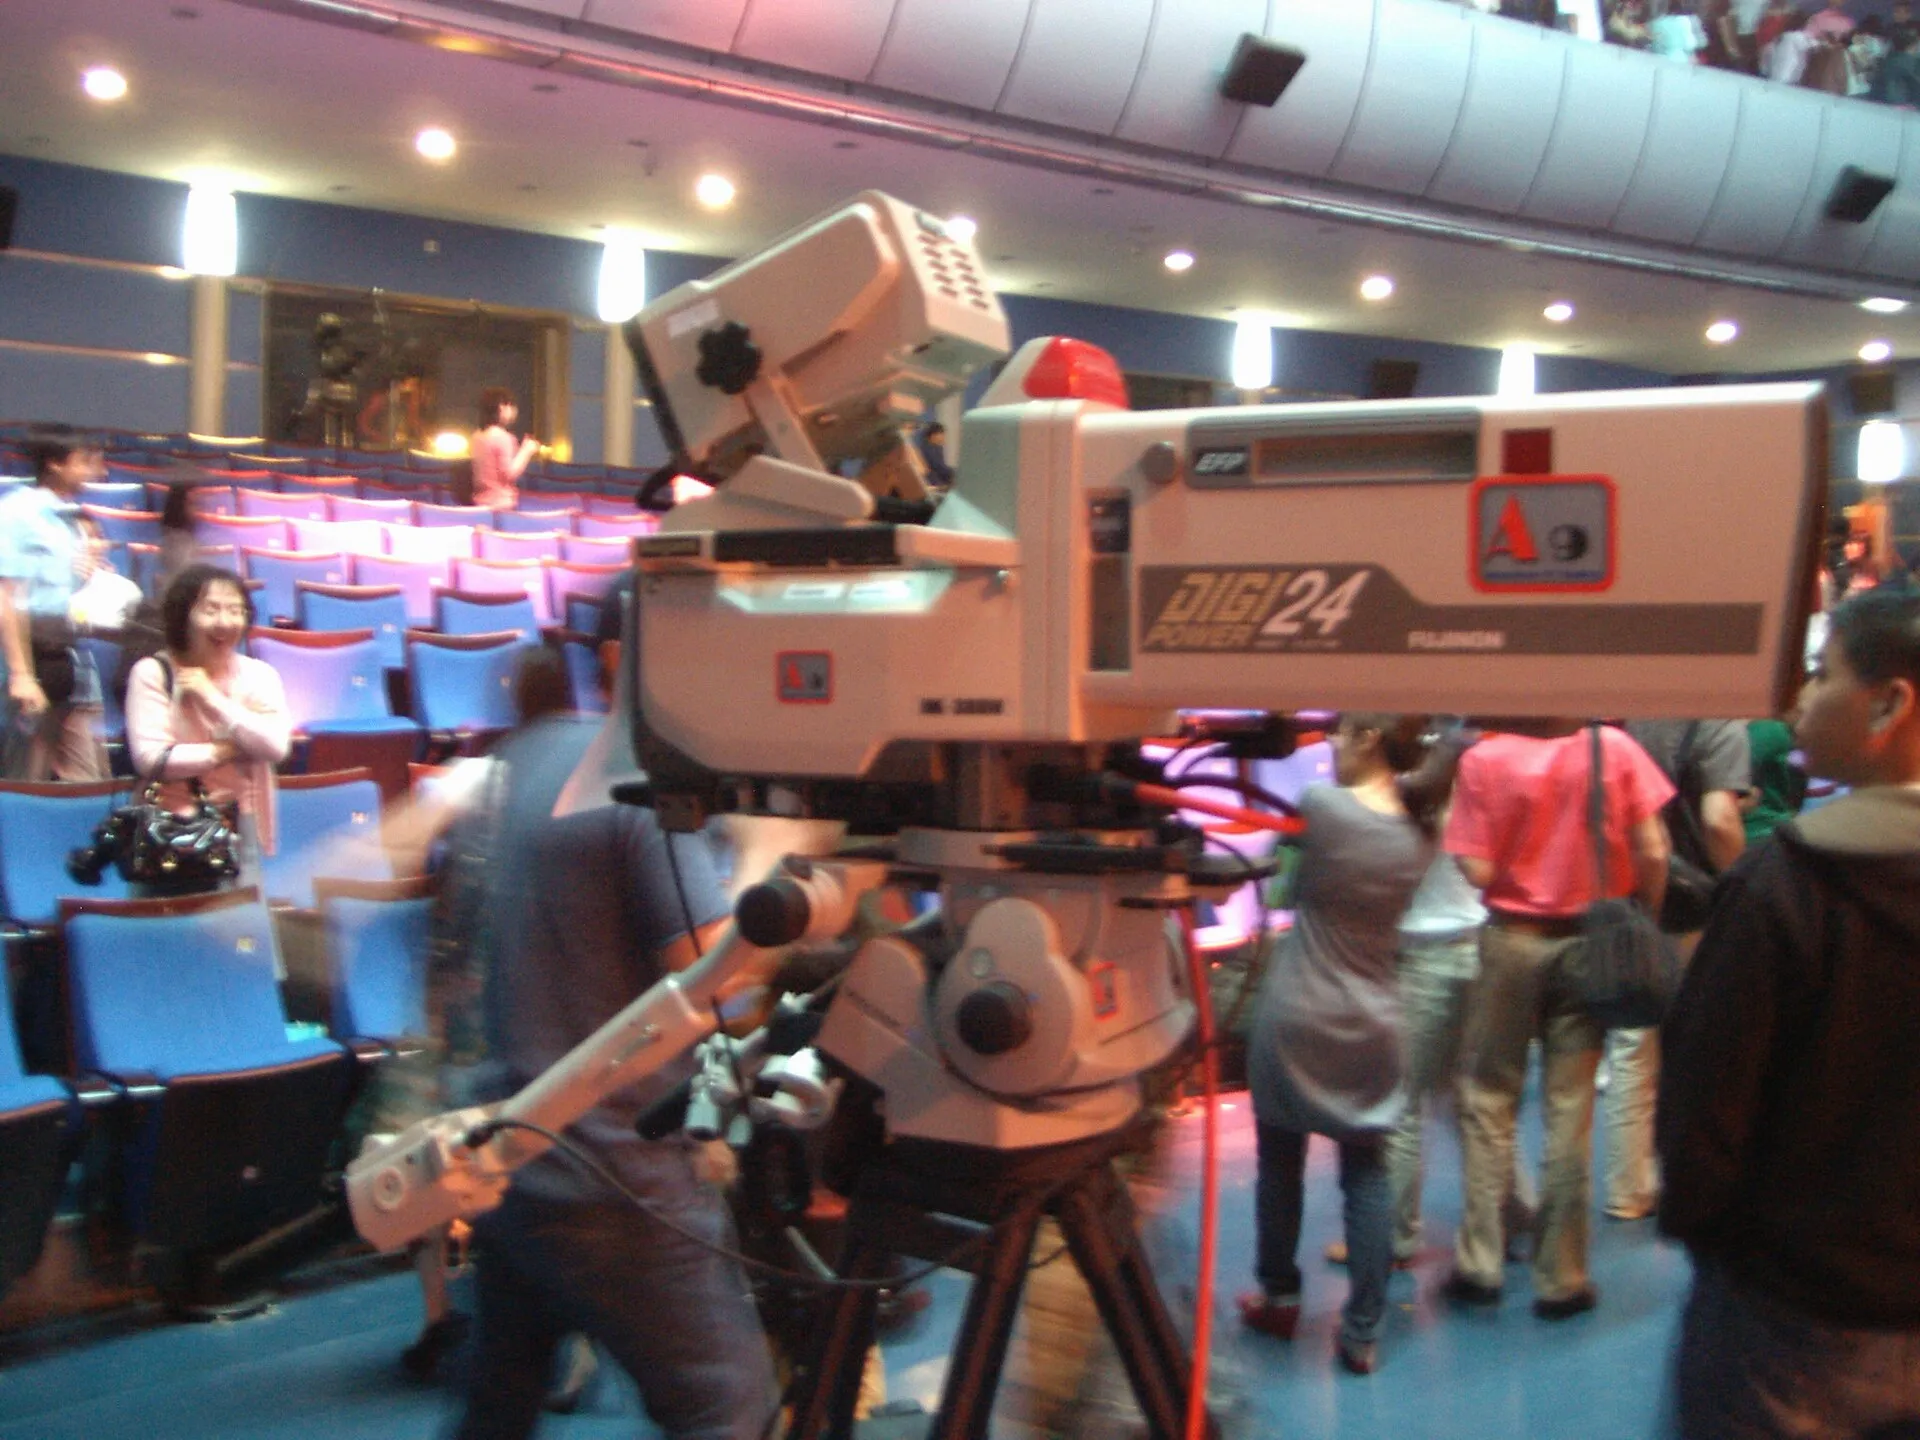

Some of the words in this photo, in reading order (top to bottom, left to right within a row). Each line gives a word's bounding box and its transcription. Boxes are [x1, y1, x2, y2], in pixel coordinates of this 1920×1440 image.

[1157, 570, 1292, 624] DIGI
[1258, 567, 1373, 636] 24
[1142, 623, 1257, 647] POWER
